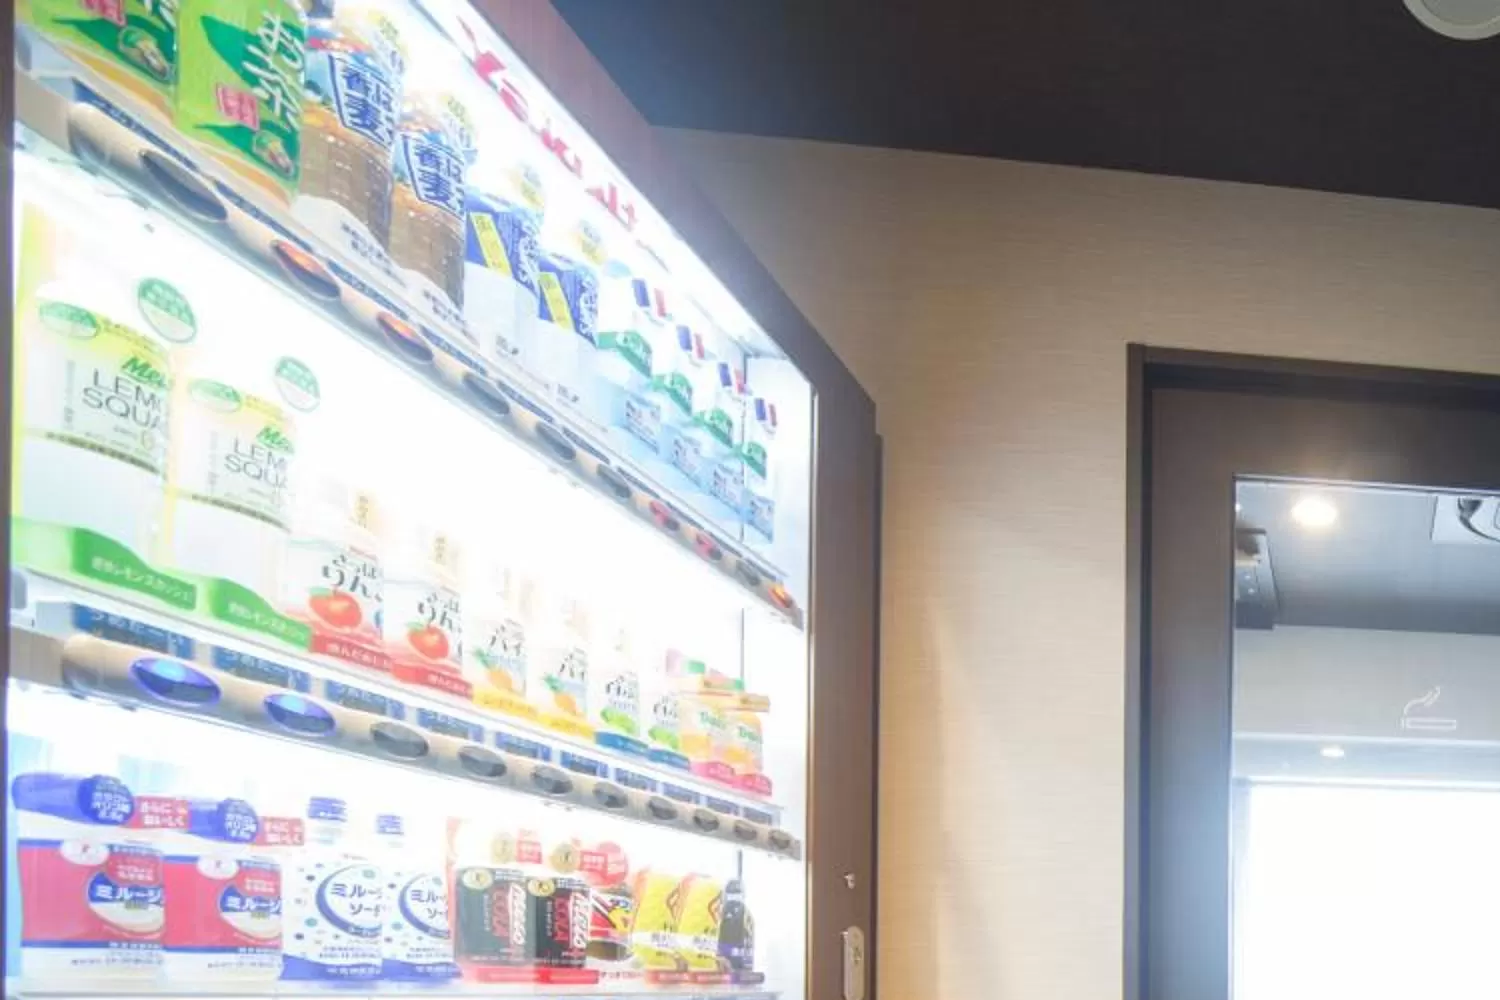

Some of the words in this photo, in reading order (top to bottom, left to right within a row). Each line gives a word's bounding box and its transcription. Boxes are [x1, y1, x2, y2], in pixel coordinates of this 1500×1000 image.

[93, 367, 162, 413] LEM
[95, 884, 163, 900] ミルージ
